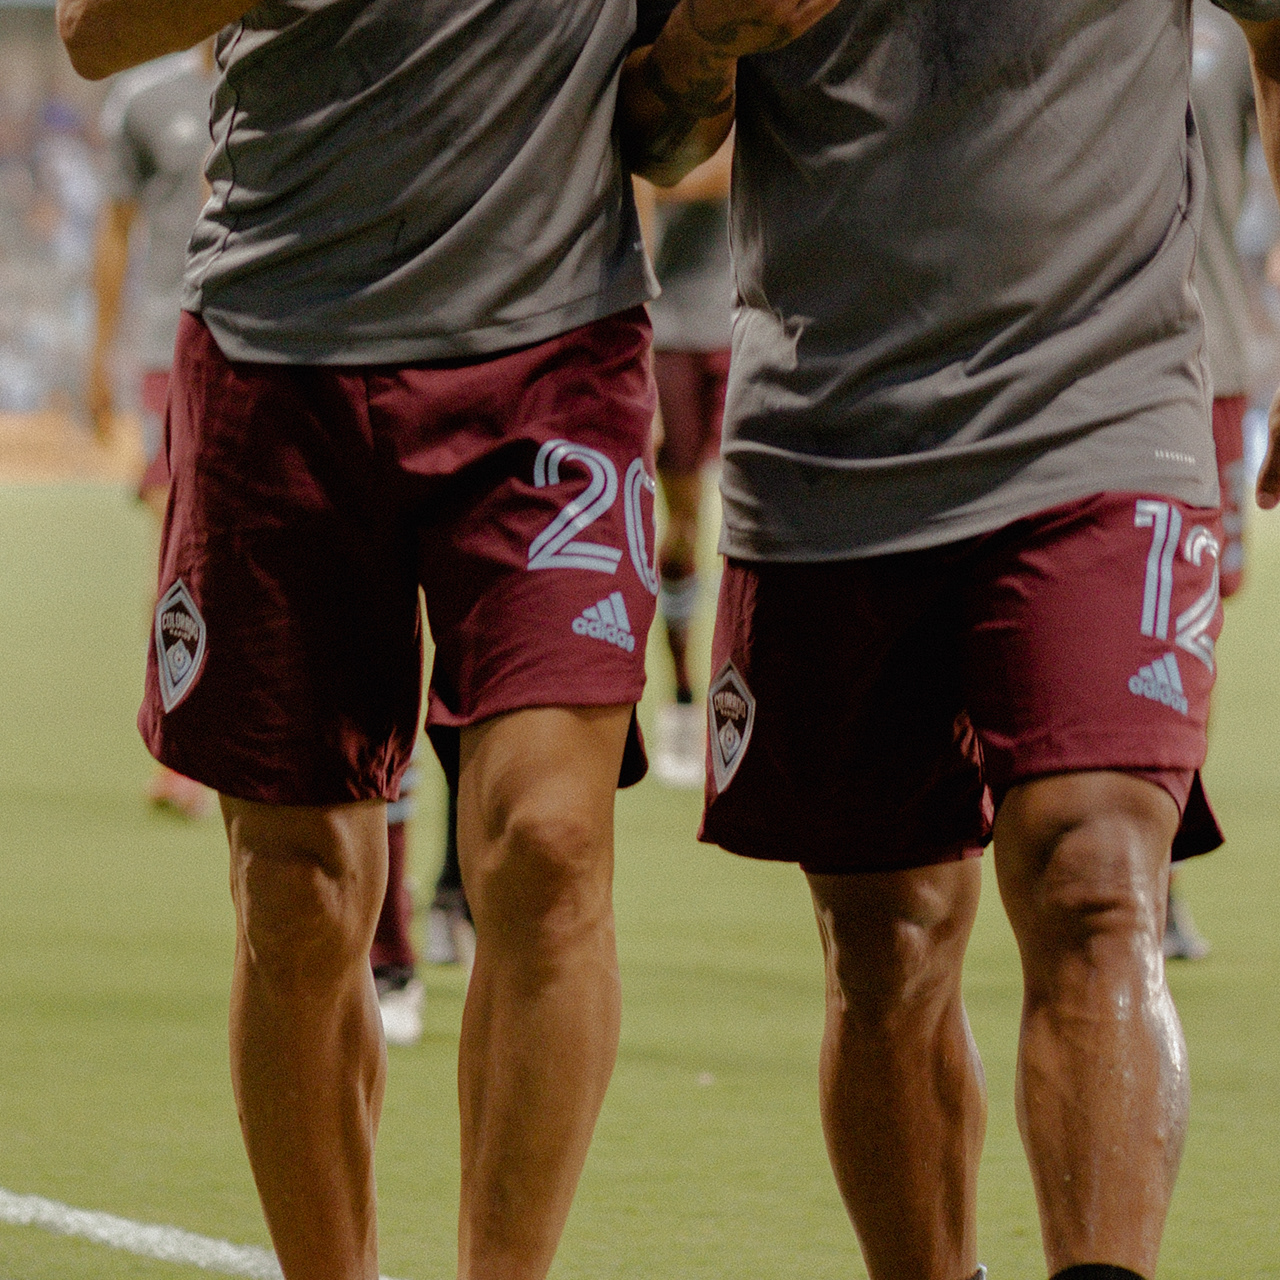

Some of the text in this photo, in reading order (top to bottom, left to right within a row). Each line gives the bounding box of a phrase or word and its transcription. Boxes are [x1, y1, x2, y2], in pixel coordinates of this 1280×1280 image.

[1135, 499, 1219, 675] 12
[572, 616, 635, 653] adidas
[1128, 675, 1188, 716] adidas
